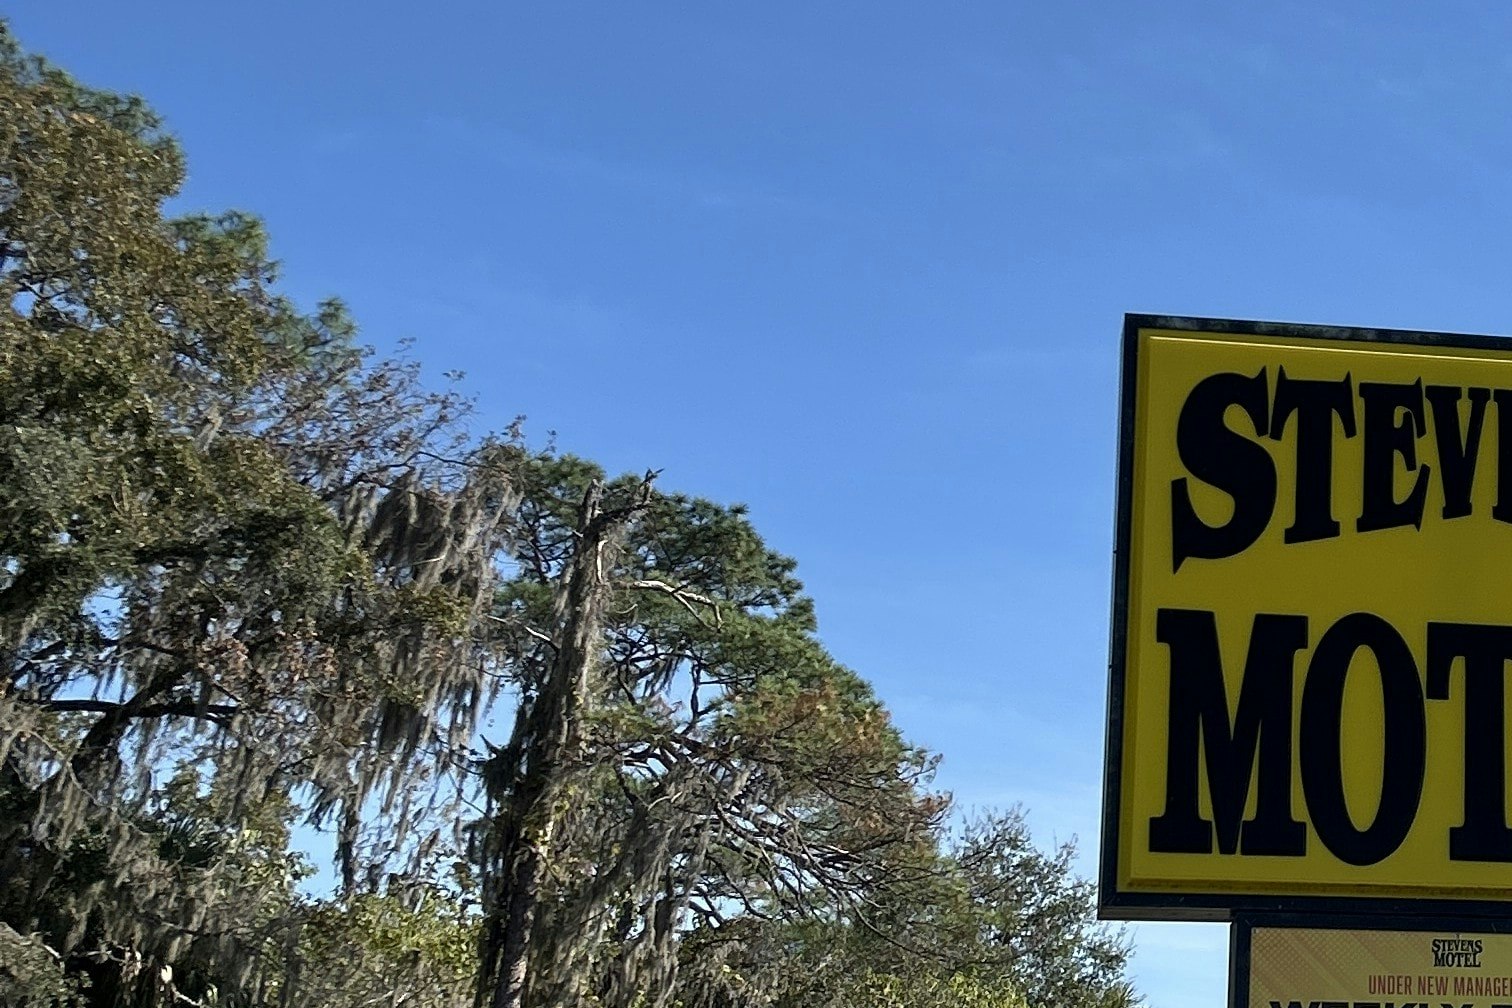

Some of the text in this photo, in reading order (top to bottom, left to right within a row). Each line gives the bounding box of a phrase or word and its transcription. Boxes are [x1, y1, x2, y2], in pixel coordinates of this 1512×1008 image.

[1431, 938, 1483, 954] STEVENS
[1433, 951, 1482, 968] MOTEL
[1368, 974, 1414, 995] UNDER
[1417, 976, 1448, 996] NEW
